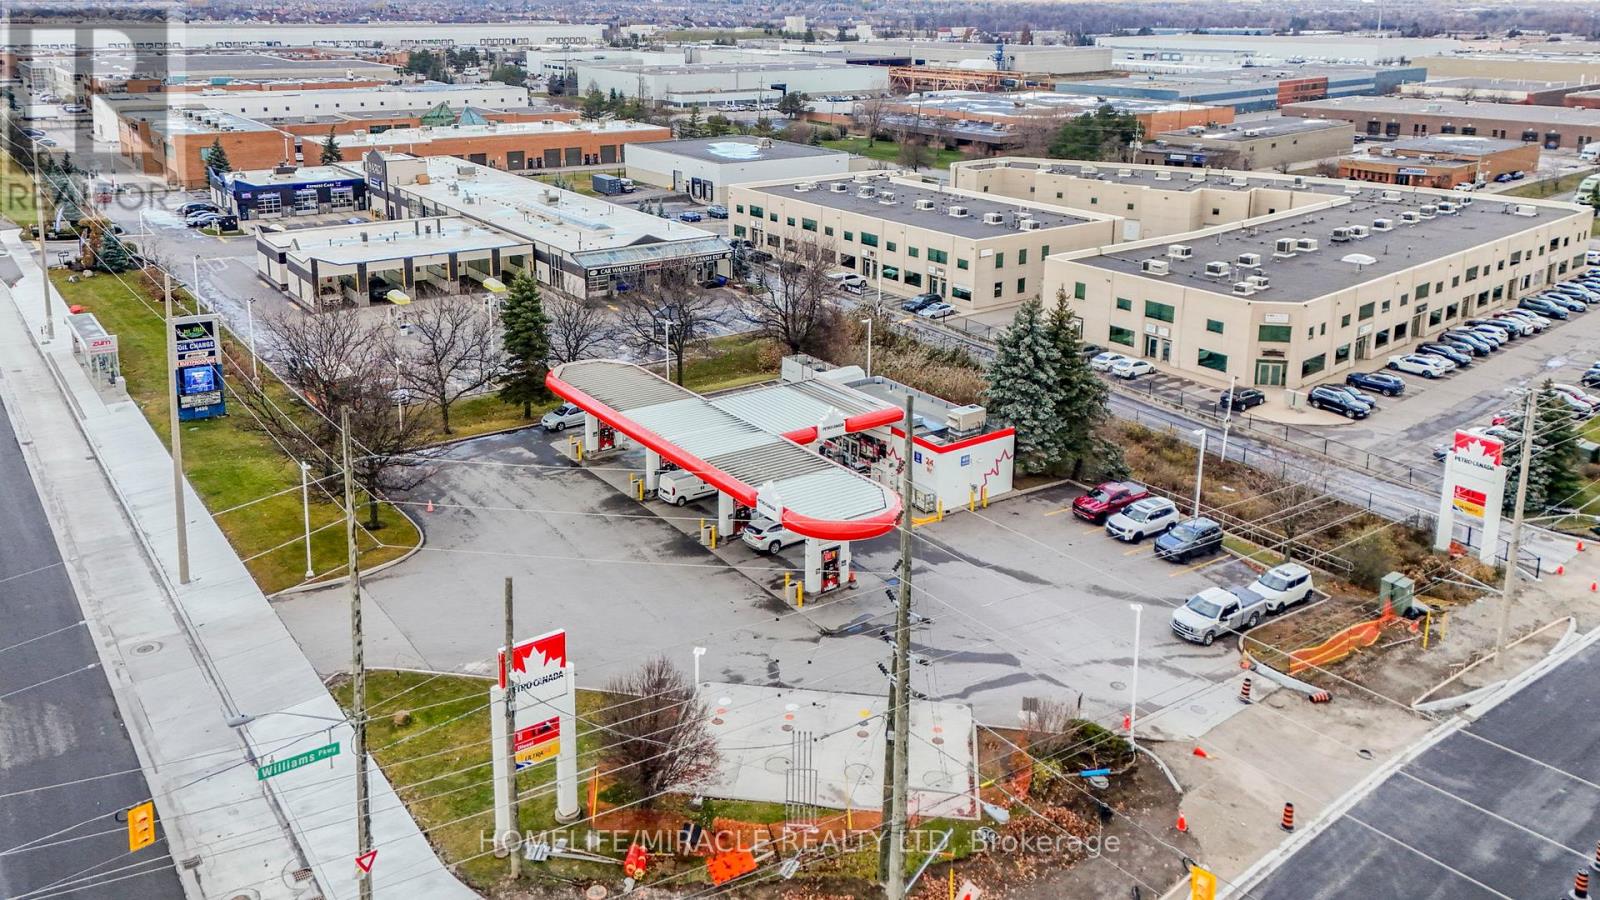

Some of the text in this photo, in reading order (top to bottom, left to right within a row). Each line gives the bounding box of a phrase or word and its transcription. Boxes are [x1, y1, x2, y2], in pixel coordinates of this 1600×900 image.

[612, 265, 629, 273] WASH
[189, 341, 214, 350] CHANGE
[261, 746, 337, 777] Williams Pkwy
